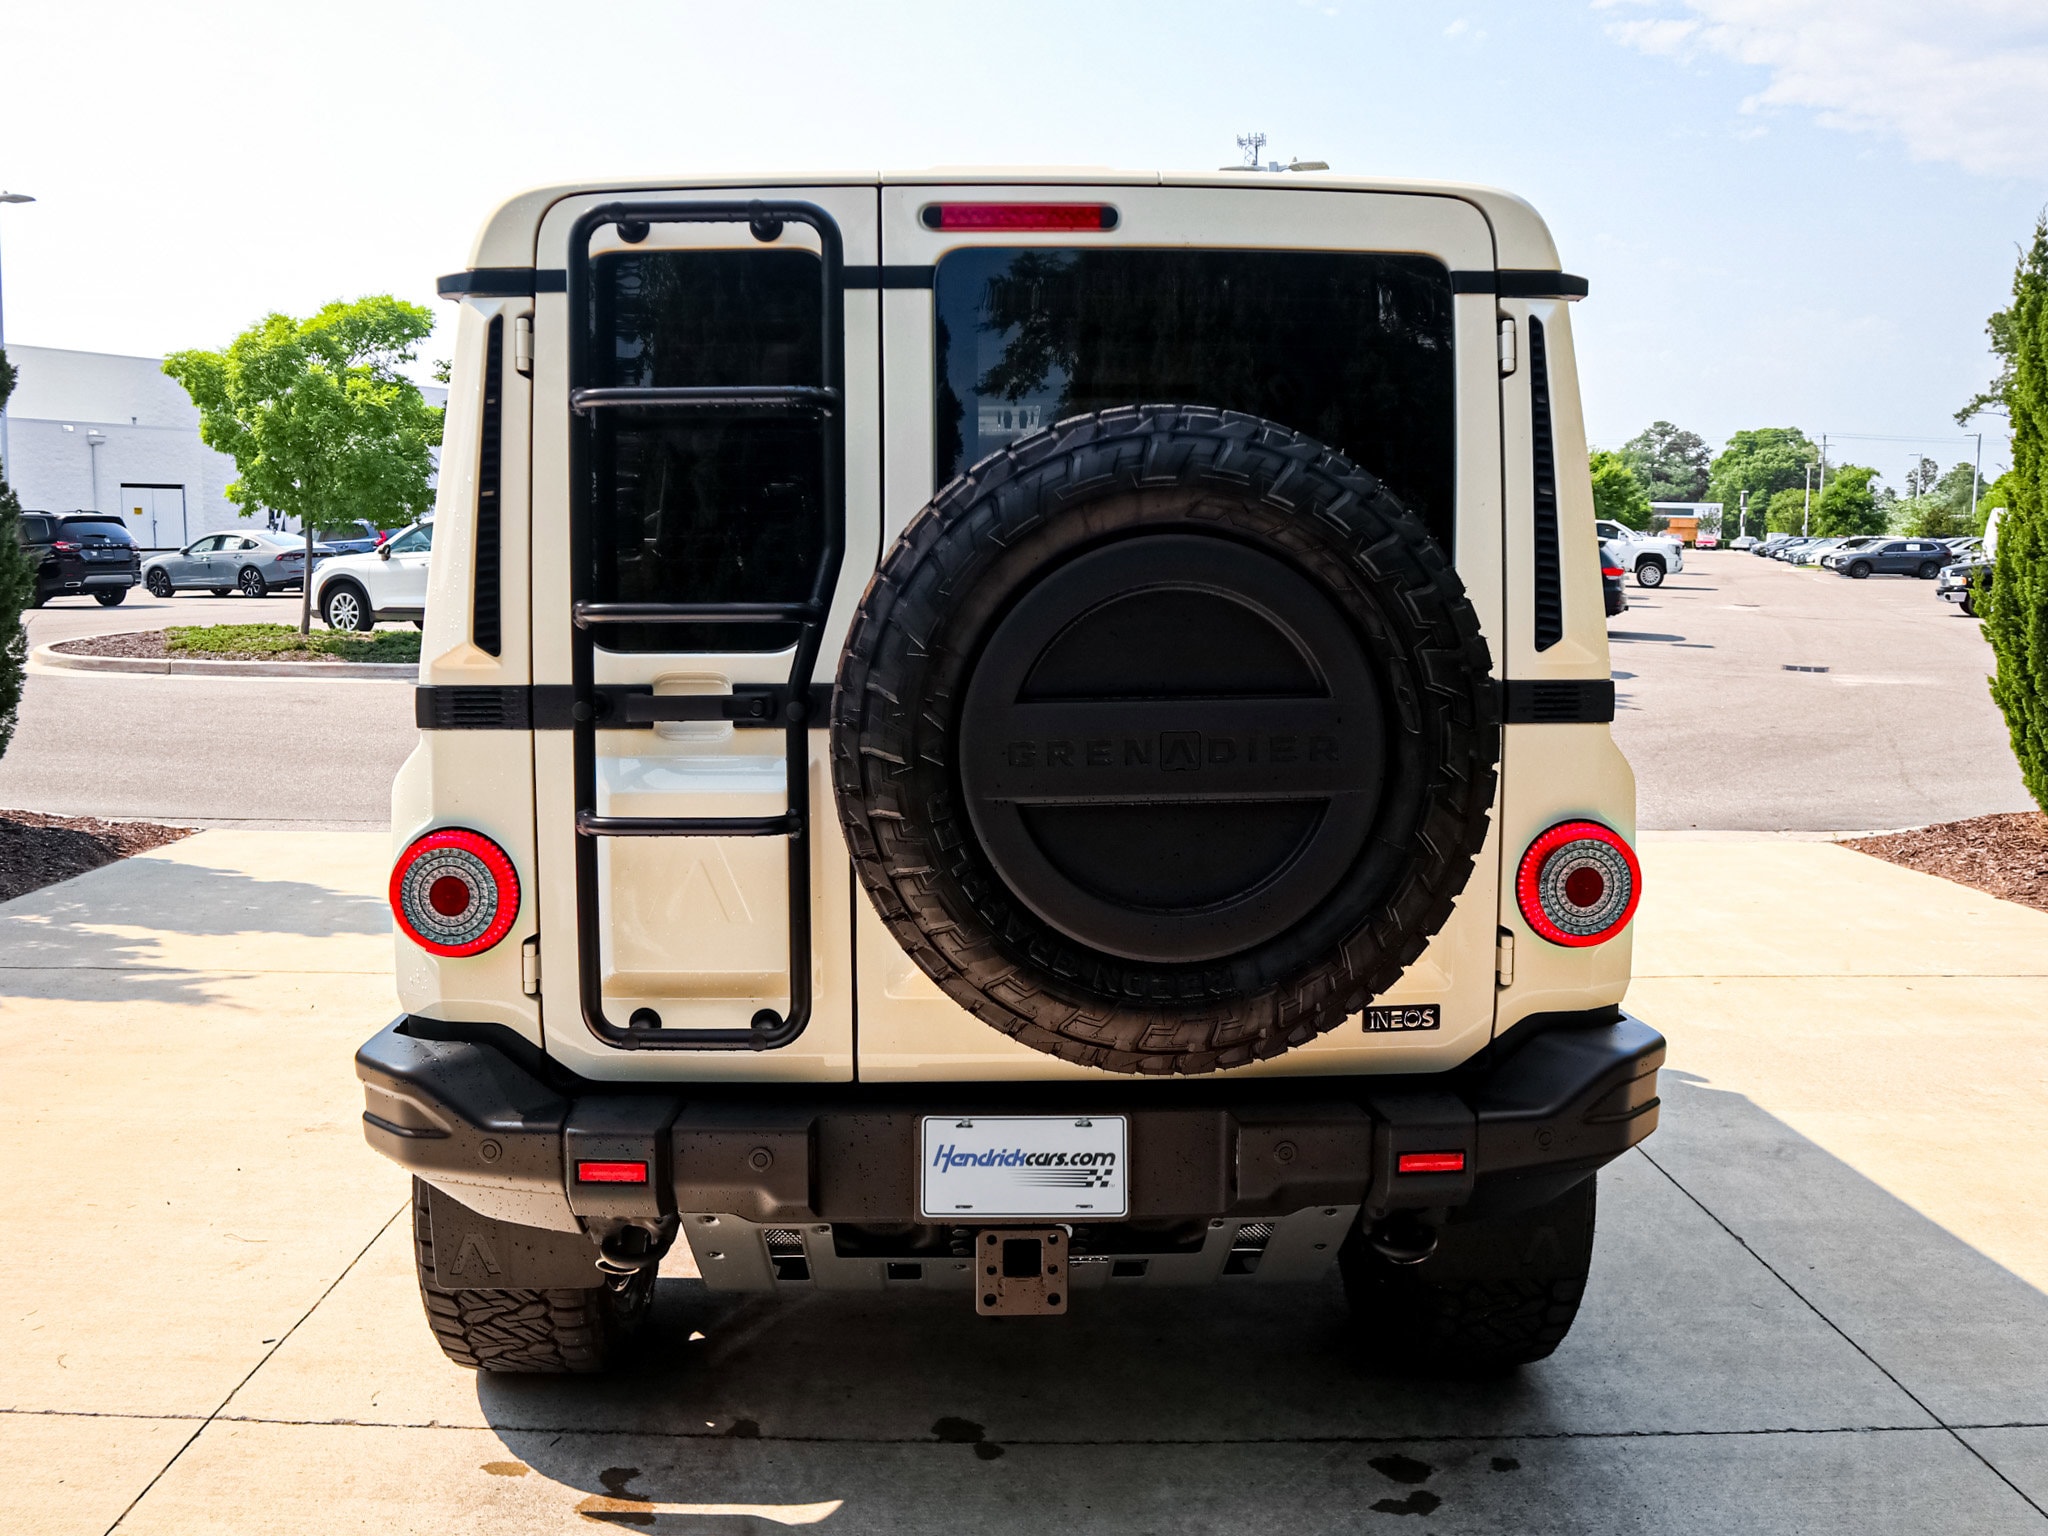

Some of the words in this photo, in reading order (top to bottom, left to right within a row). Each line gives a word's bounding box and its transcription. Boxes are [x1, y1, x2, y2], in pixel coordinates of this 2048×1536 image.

[1007, 731, 1341, 768] GRENADIER
[1089, 963, 1237, 1000] RECON
[1369, 1009, 1434, 1029] INEOS
[933, 1144, 1116, 1173] Hendrickcars.com
